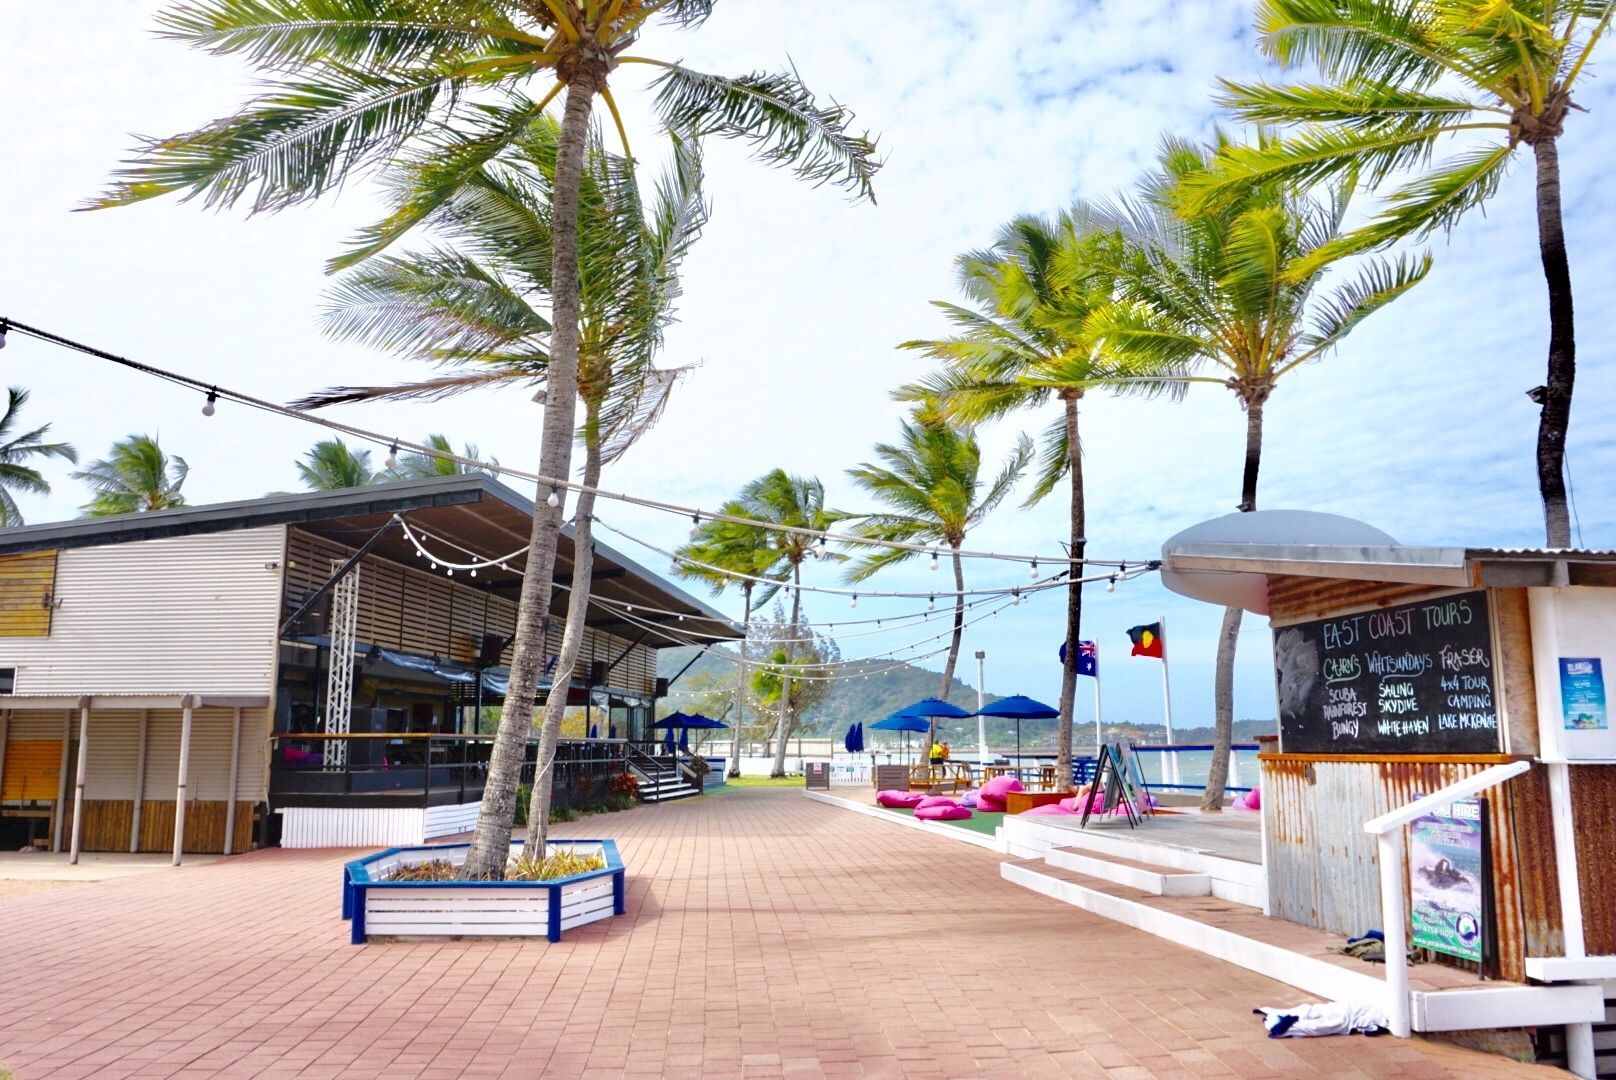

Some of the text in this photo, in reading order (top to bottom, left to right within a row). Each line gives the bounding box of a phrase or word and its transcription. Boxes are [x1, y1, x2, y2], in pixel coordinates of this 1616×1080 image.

[1323, 599, 1472, 650] EAST COAST TOURS
[1323, 653, 1362, 680] CAIRNS
[1365, 649, 1433, 677] WHITSUNDAYS
[1439, 645, 1490, 672] FRASER
[1378, 681, 1414, 698] SAILING
[1461, 675, 1491, 694] TOUR
[1329, 687, 1357, 704] SCUBA
[1447, 693, 1491, 709] CAMPING
[1322, 702, 1368, 720] RAINFOREST
[1331, 717, 1359, 740] BUNGY
[1438, 713, 1458, 730] LAKE
[1452, 803, 1480, 821] HIRE
